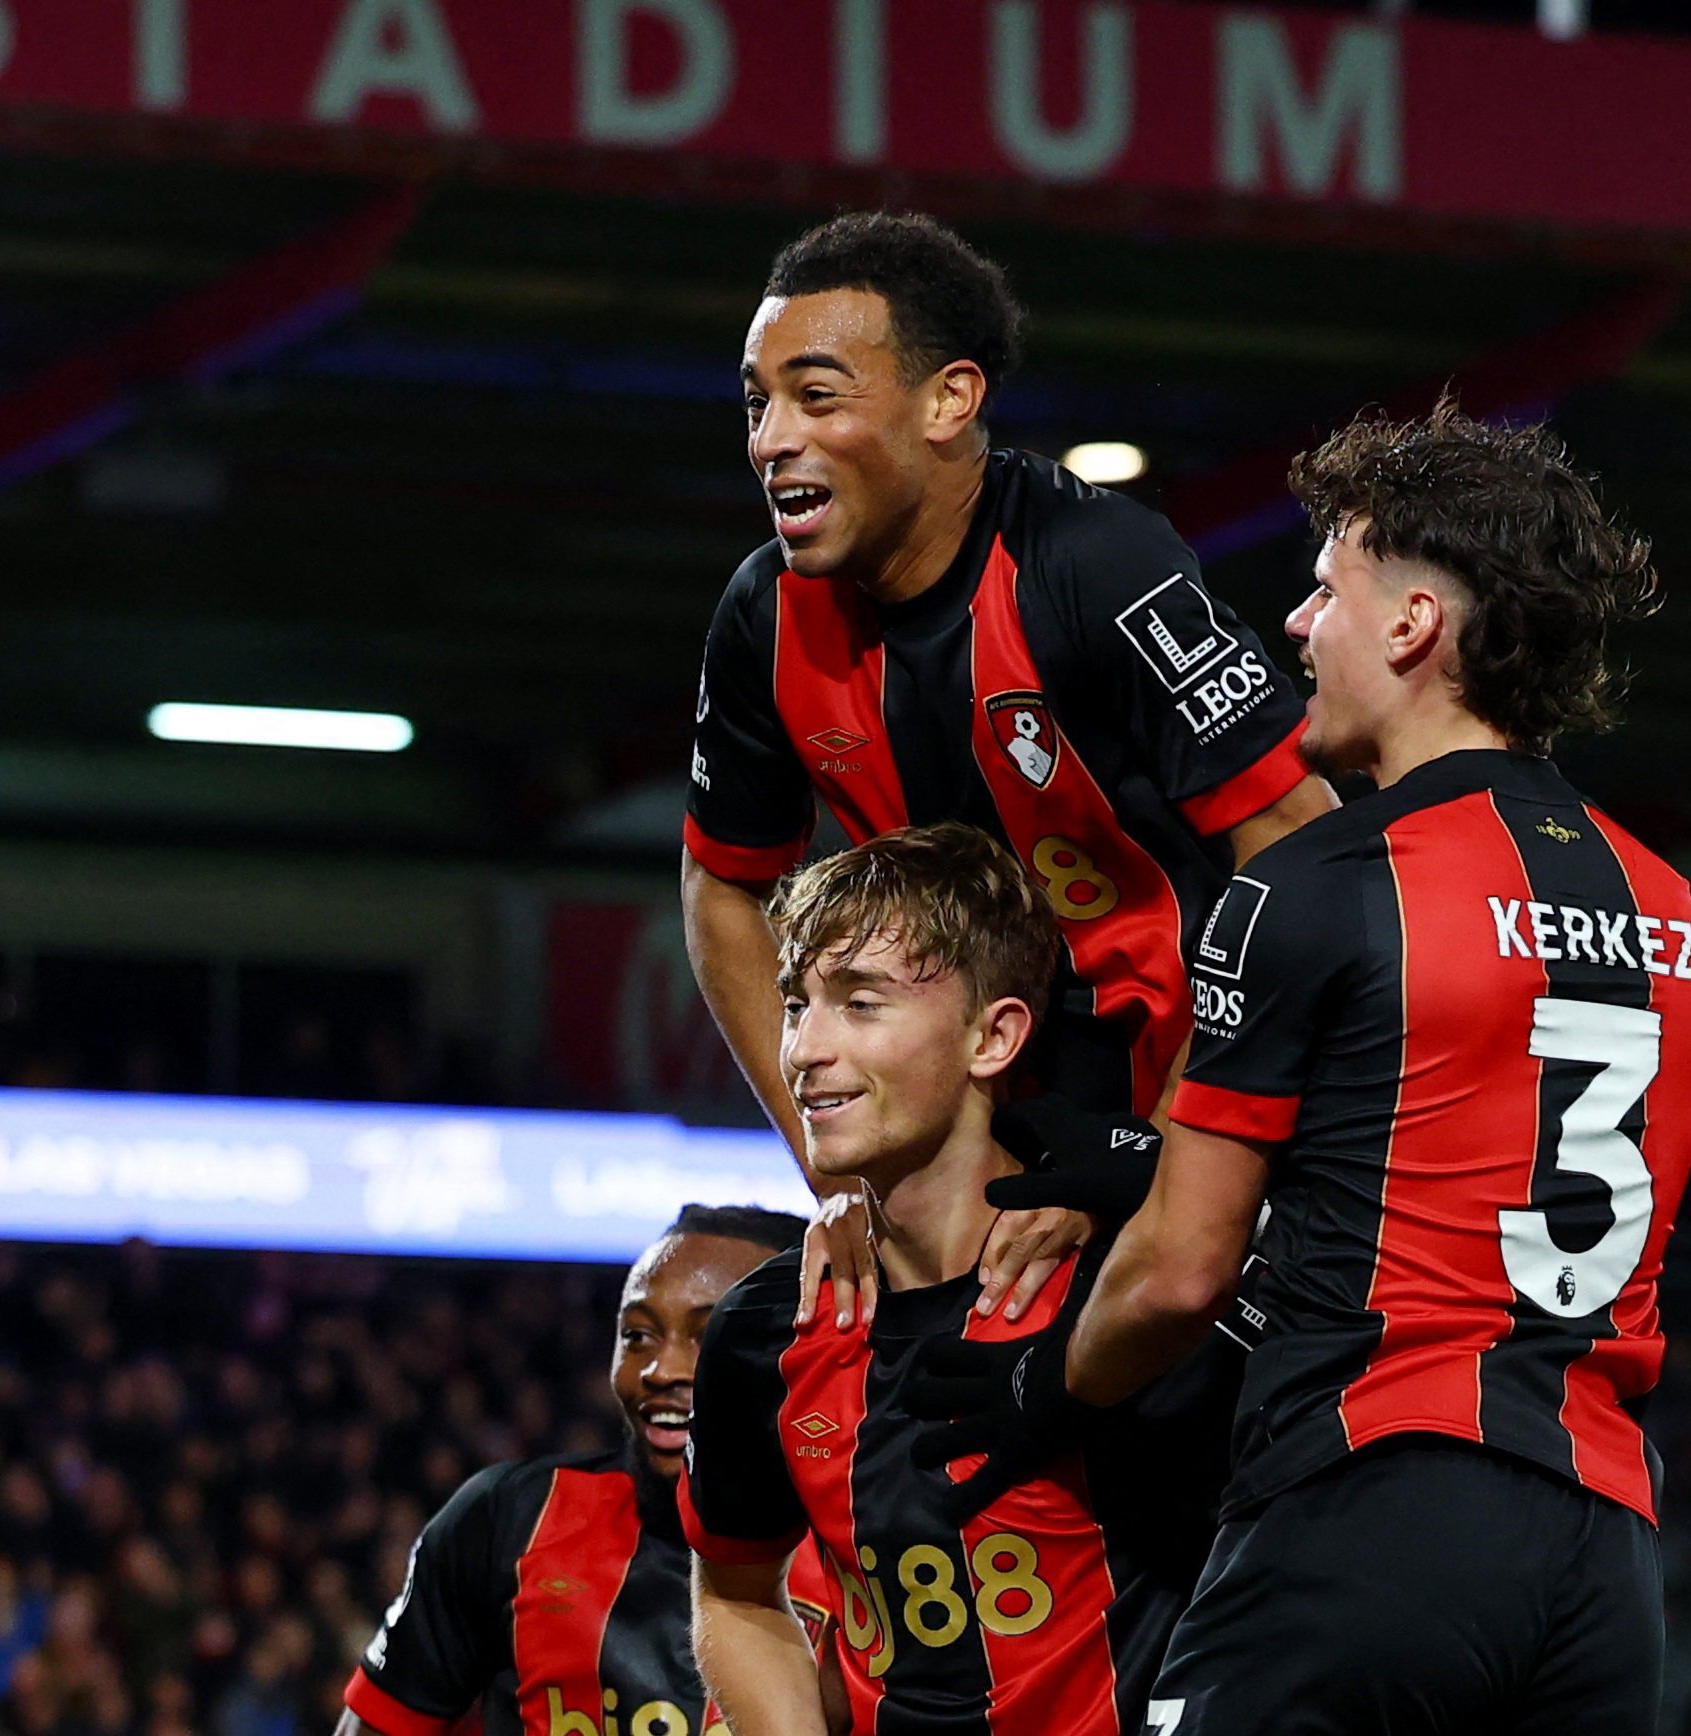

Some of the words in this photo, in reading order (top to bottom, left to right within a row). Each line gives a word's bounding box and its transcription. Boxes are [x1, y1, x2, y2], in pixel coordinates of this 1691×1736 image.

[1176, 651, 1267, 734] LEOS
[1198, 684, 1275, 746] INTERNATIONAL
[1498, 997, 1662, 1319] 3
[796, 1445, 831, 1459] umbro
[824, 1533, 1053, 1678] bj88
